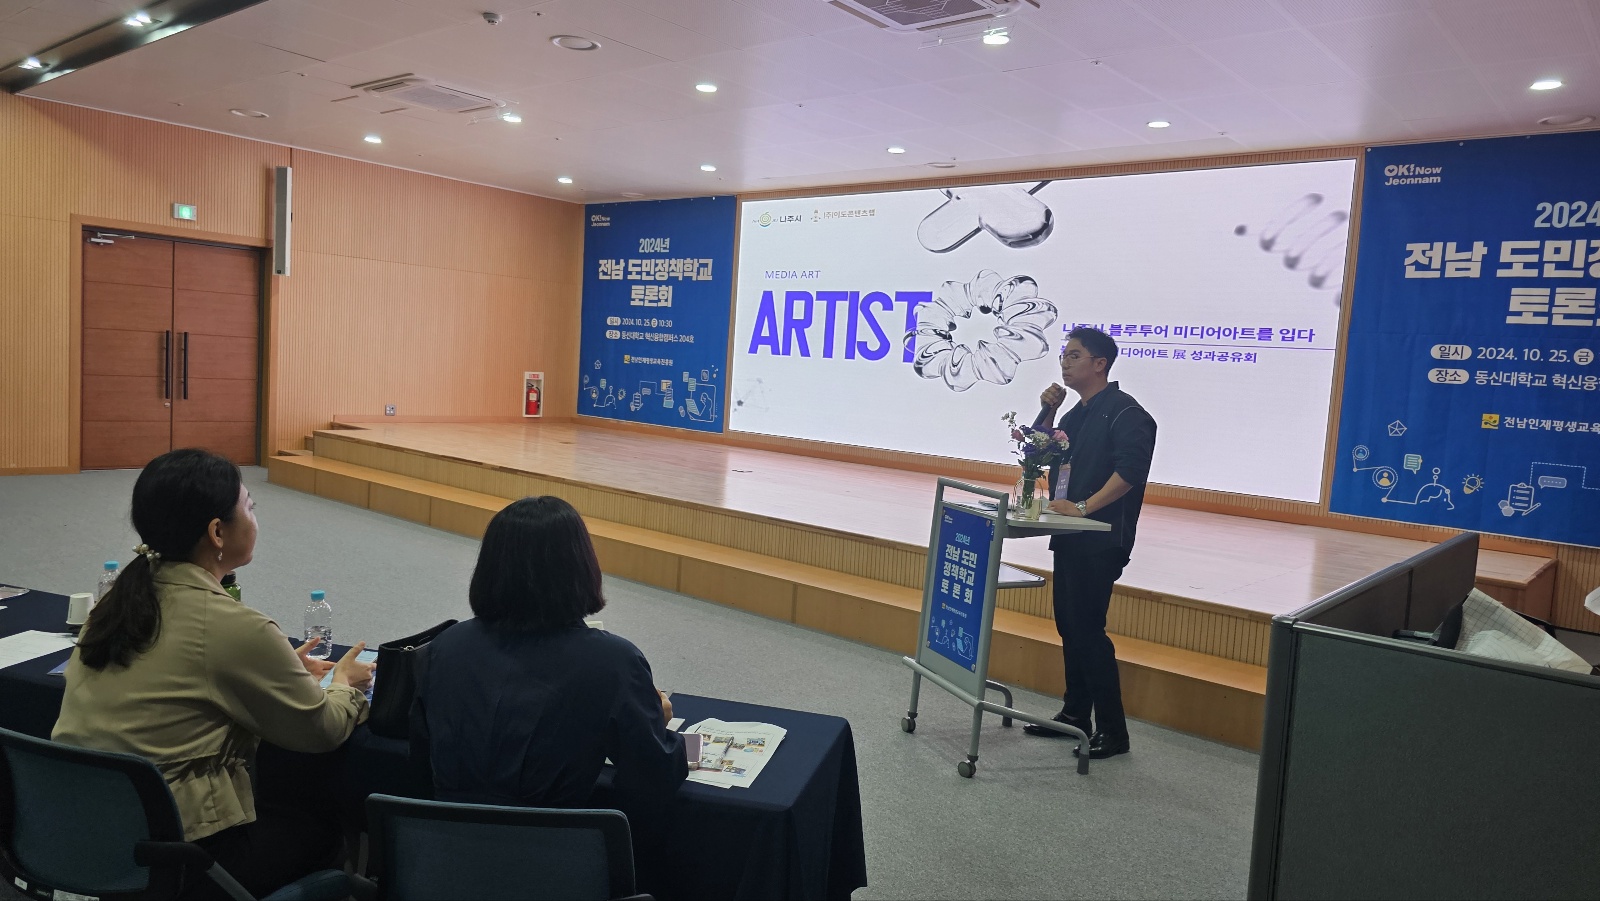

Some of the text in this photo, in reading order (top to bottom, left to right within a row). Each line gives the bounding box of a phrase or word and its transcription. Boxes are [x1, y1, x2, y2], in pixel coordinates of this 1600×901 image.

[1384, 176, 1441, 186] Jeonnam
[779, 214, 802, 223] 나주시
[638, 237, 670, 253] 2024년
[598, 258, 713, 281] 전남 도민정책학교
[1403, 240, 1488, 279] 전남
[764, 269, 821, 280] MEDIA ART
[630, 284, 673, 308] 토론회
[1505, 286, 1600, 327] 토론
[747, 290, 933, 363] ARTIST
[1108, 323, 1169, 339] 블루투어
[1173, 324, 1274, 342] 미디어아트를
[1279, 327, 1316, 343] 입다
[1118, 346, 1258, 364] 디어아트 展 성과공유회
[1438, 345, 1465, 359] 일시
[1476, 346, 1518, 361] 2024.
[1523, 348, 1544, 362] 10.
[1548, 349, 1571, 363] 25.
[1435, 369, 1600, 392] 장소 동신대학교 혁신융
[945, 543, 978, 569] 전남 도민
[943, 561, 976, 587] 정책학교
